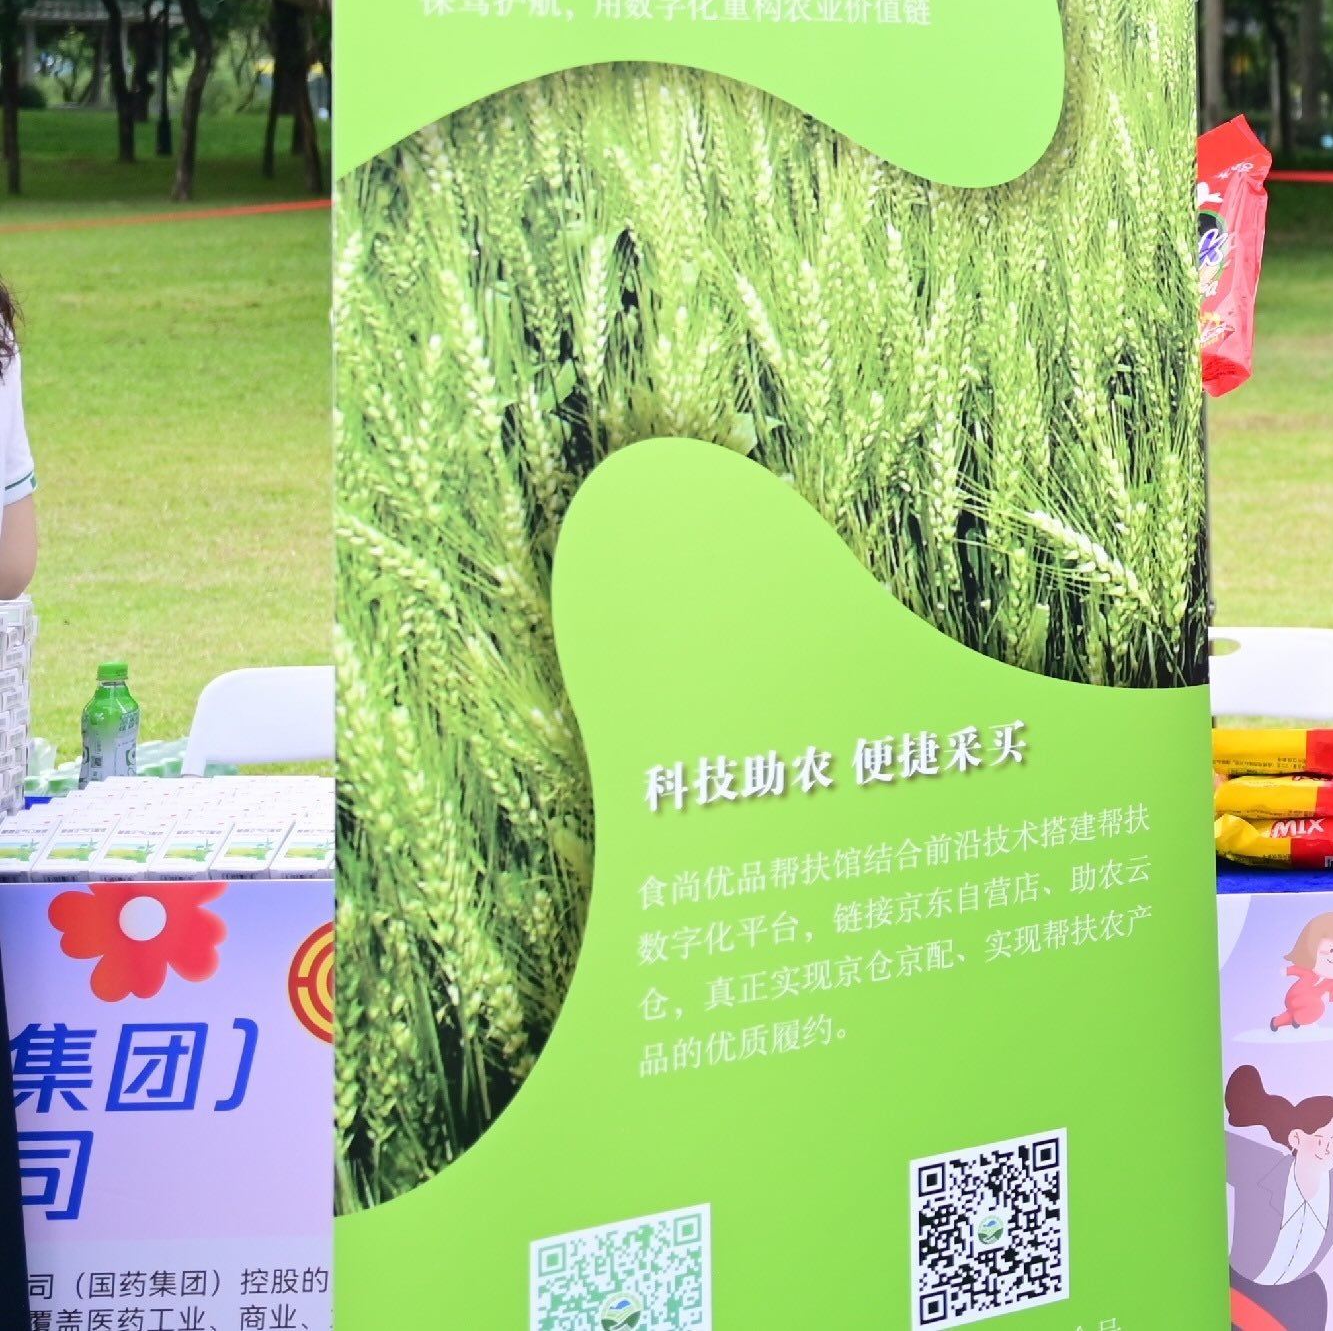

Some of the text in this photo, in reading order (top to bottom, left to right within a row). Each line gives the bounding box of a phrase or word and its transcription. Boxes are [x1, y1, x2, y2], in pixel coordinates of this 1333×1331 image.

[643, 717, 1029, 814] 科技助农 便捷采买
[639, 803, 1151, 912] 食尚优品帮扶馆结合前沿技术搭建帮扶
[639, 854, 1152, 966] 数字化平台，链接京东自营店、助农云
[639, 904, 1153, 1023] 仓，真正实现京仓京配、实现帮扶农产
[639, 1016, 849, 1078] 品的优质履约。
